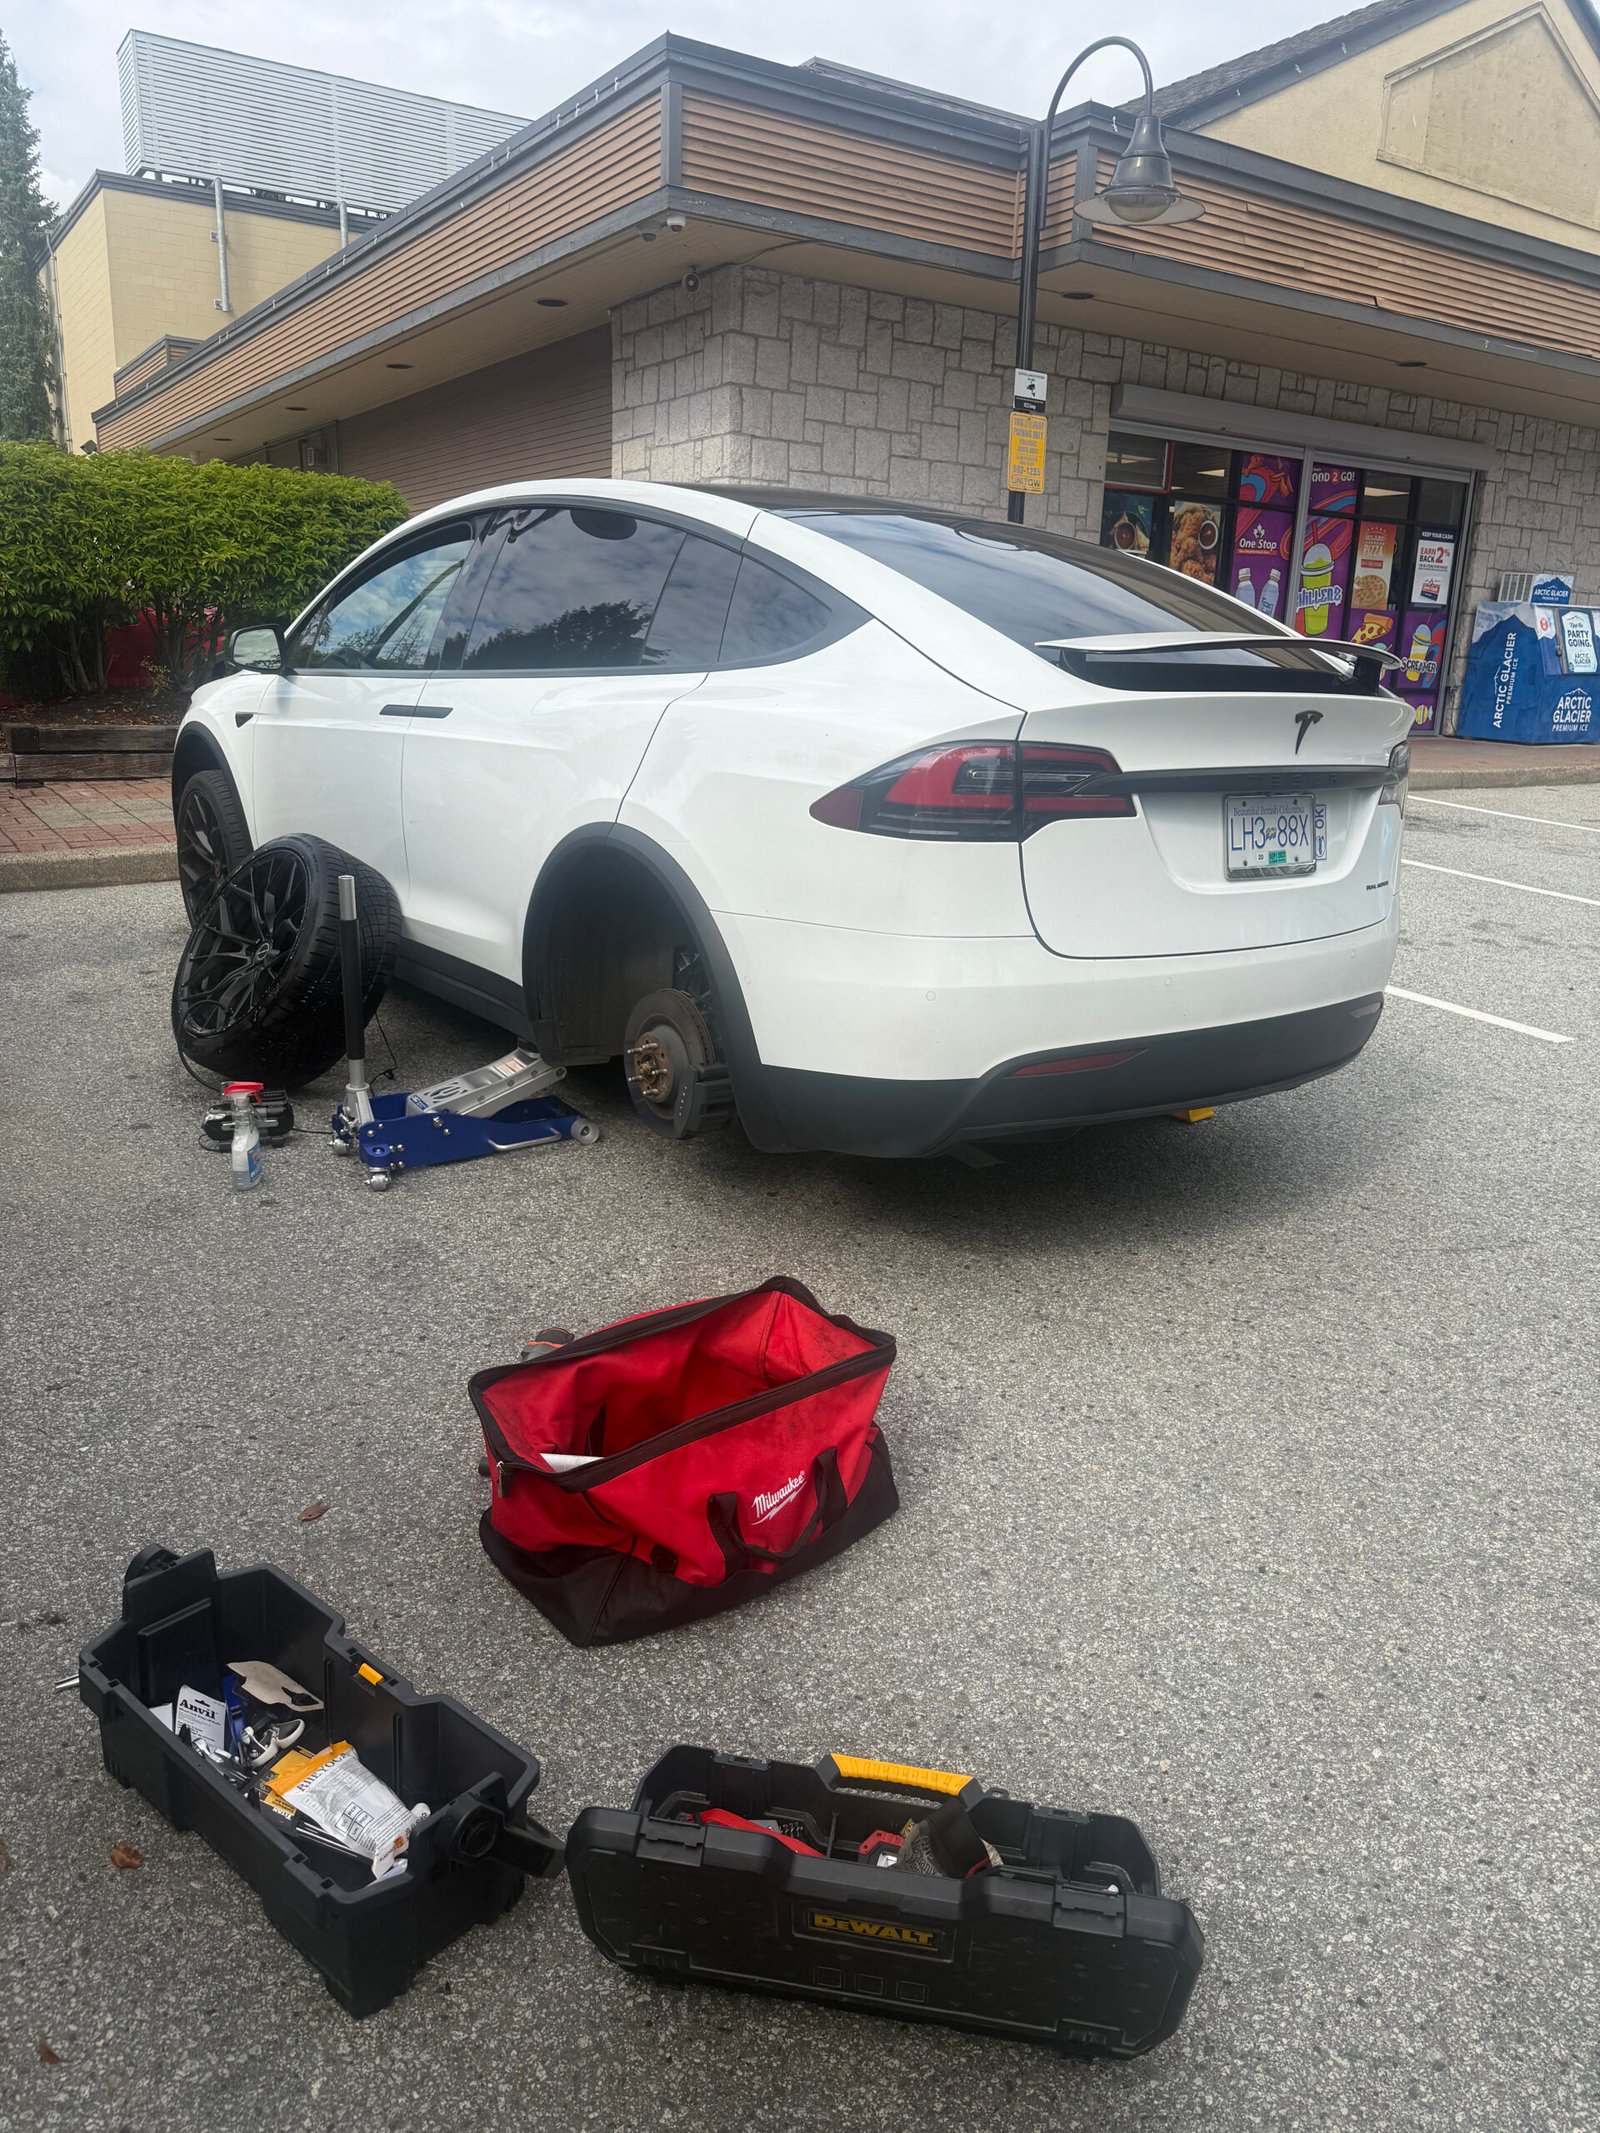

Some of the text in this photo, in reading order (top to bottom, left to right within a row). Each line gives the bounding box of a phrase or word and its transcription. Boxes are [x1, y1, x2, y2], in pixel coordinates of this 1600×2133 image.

[1311, 472, 1331, 482] OOD
[1340, 471, 1356, 482] GO!
[1239, 538, 1277, 551] One Stop
[1363, 544, 1384, 556] PIZZA
[1420, 547, 1436, 556] EARN
[1419, 554, 1436, 563] BACK
[1534, 588, 1569, 598] ARCTIC GLACIER
[1567, 629, 1589, 638] PARTY
[1568, 638, 1592, 647] GOING.
[1493, 632, 1517, 728] ARCTIC GLACIER
[1505, 671, 1516, 704] PREMIUM
[1556, 696, 1592, 710] ARCTIC
[1552, 709, 1592, 723] GLACIER
[1551, 723, 1589, 731] PREMIUM ICE
[1314, 808, 1325, 829] OK
[1230, 814, 1309, 851] LH3 88X
[751, 1474, 805, 1518] Milwaukee
[180, 1699, 216, 1720] Anvil
